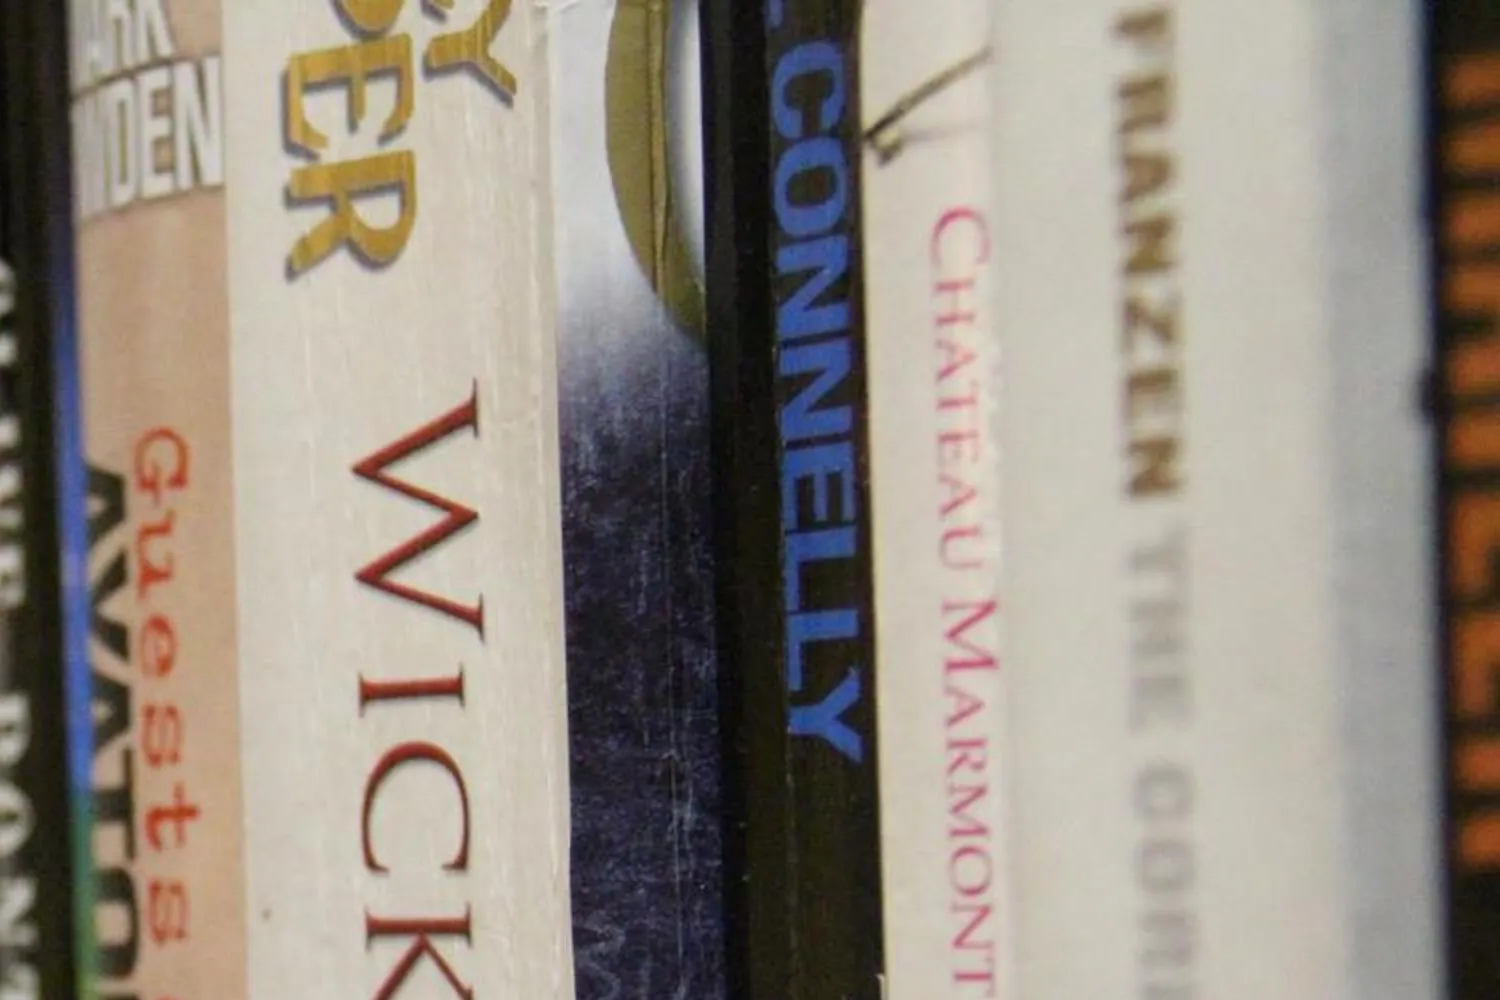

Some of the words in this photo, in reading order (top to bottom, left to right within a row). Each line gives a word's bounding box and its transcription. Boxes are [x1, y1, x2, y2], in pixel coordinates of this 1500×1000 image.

[770, 40, 864, 764] CONNELLY
[930, 206, 991, 572] CHATEAU
[1112, 4, 1184, 502] FRANZEN
[133, 426, 201, 944] Guests
[940, 598, 1001, 998] MARMONT
[1127, 530, 1194, 730] THE
